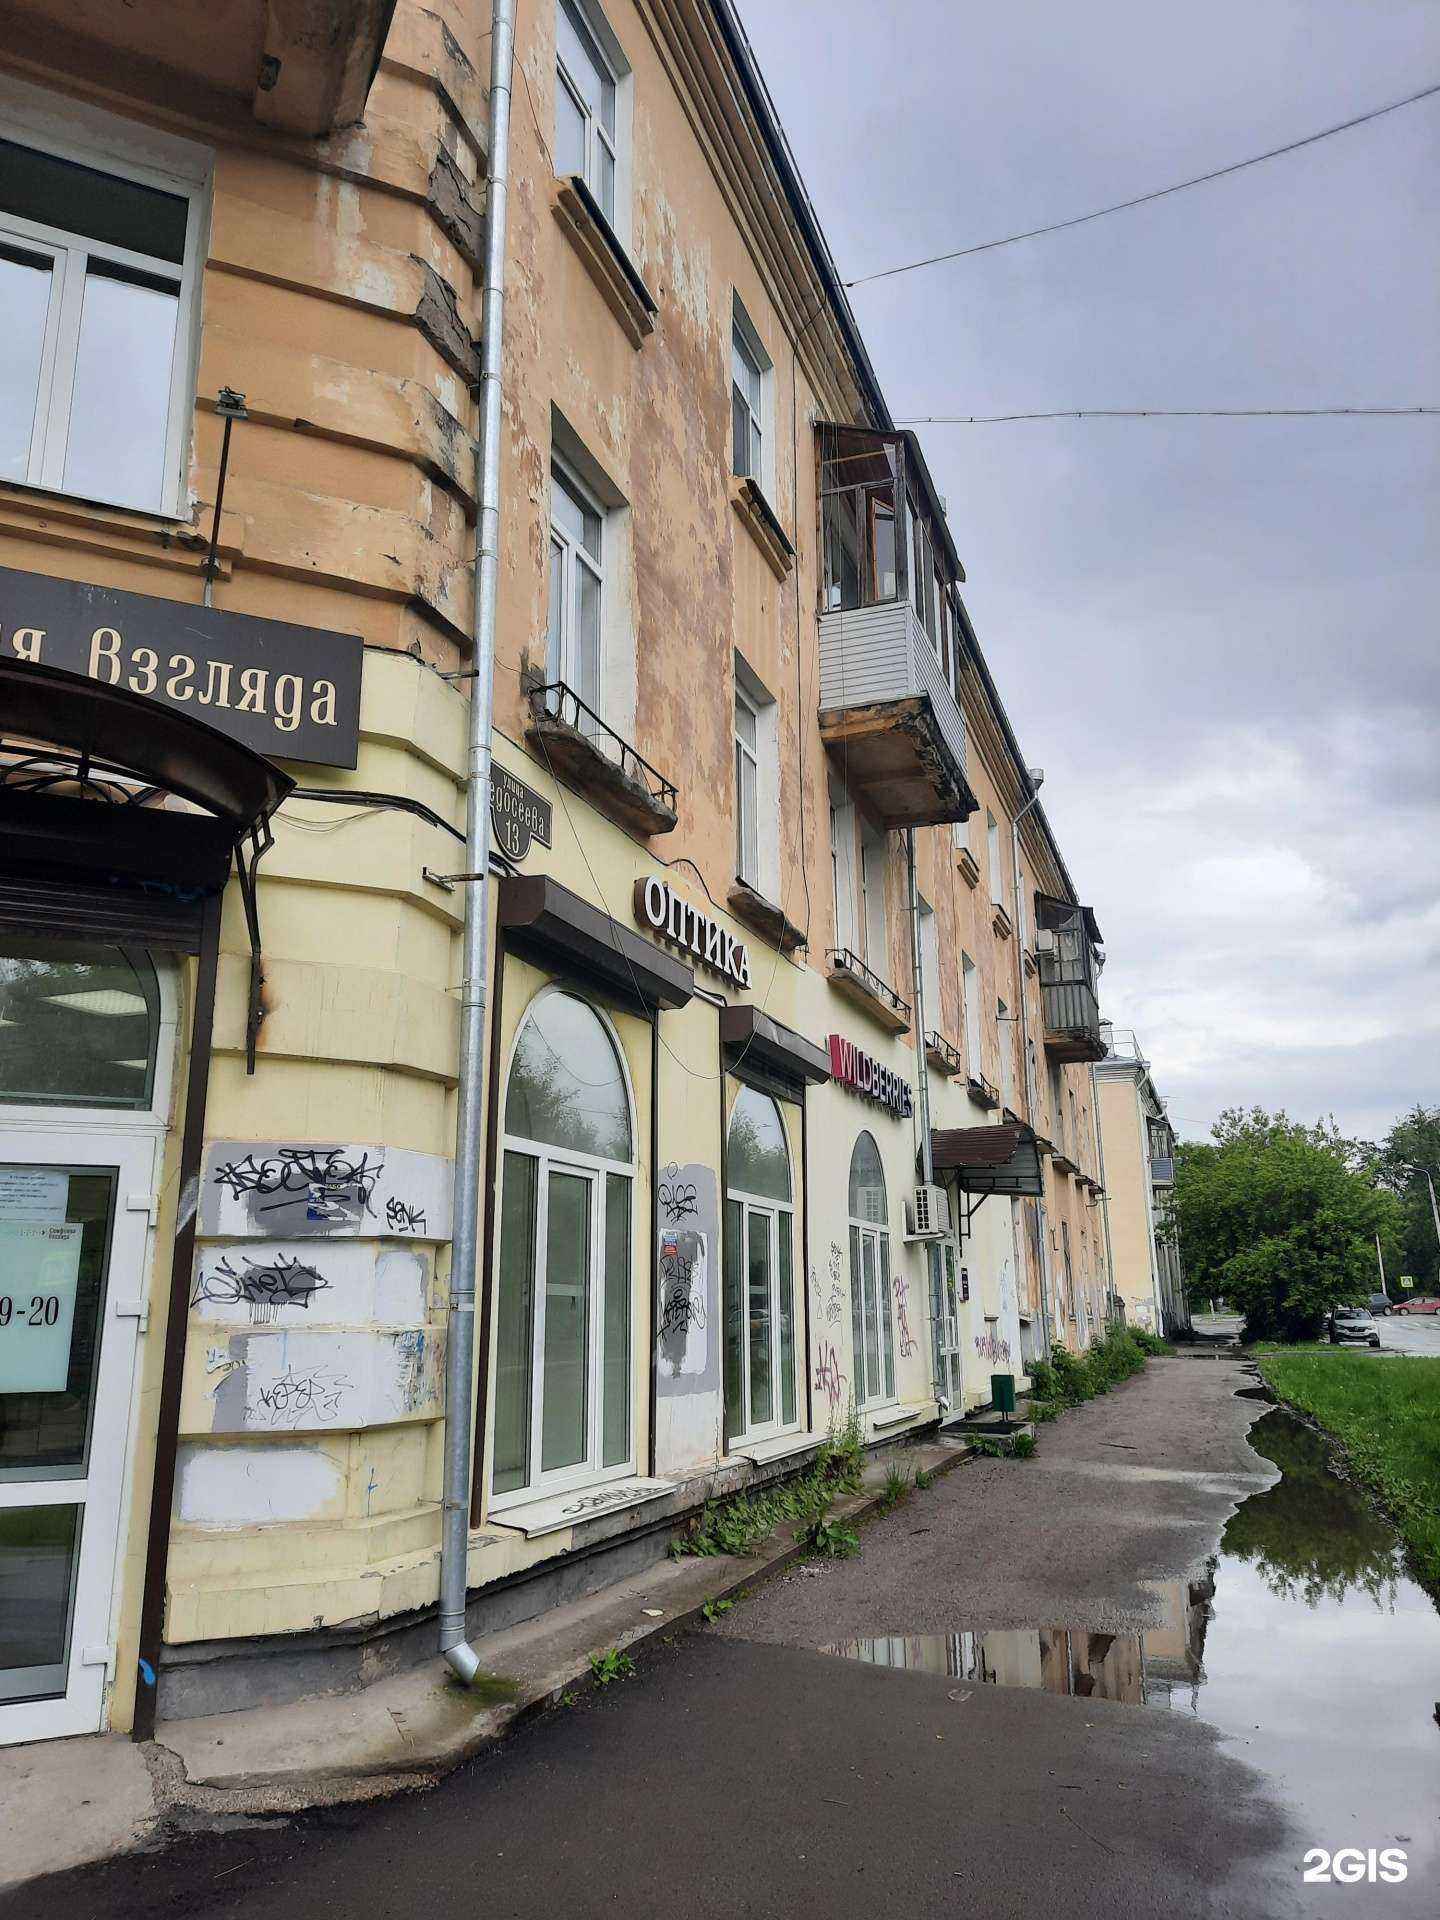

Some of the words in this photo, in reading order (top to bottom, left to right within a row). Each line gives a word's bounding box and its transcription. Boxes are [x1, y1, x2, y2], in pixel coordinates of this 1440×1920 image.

[0, 624, 46, 662] я
[88, 627, 338, 732] взгляда
[490, 781, 545, 837] едосеева
[505, 819, 520, 854] 13
[641, 874, 752, 988] ОПТИКА
[830, 1034, 912, 1117] WILDBERRIES
